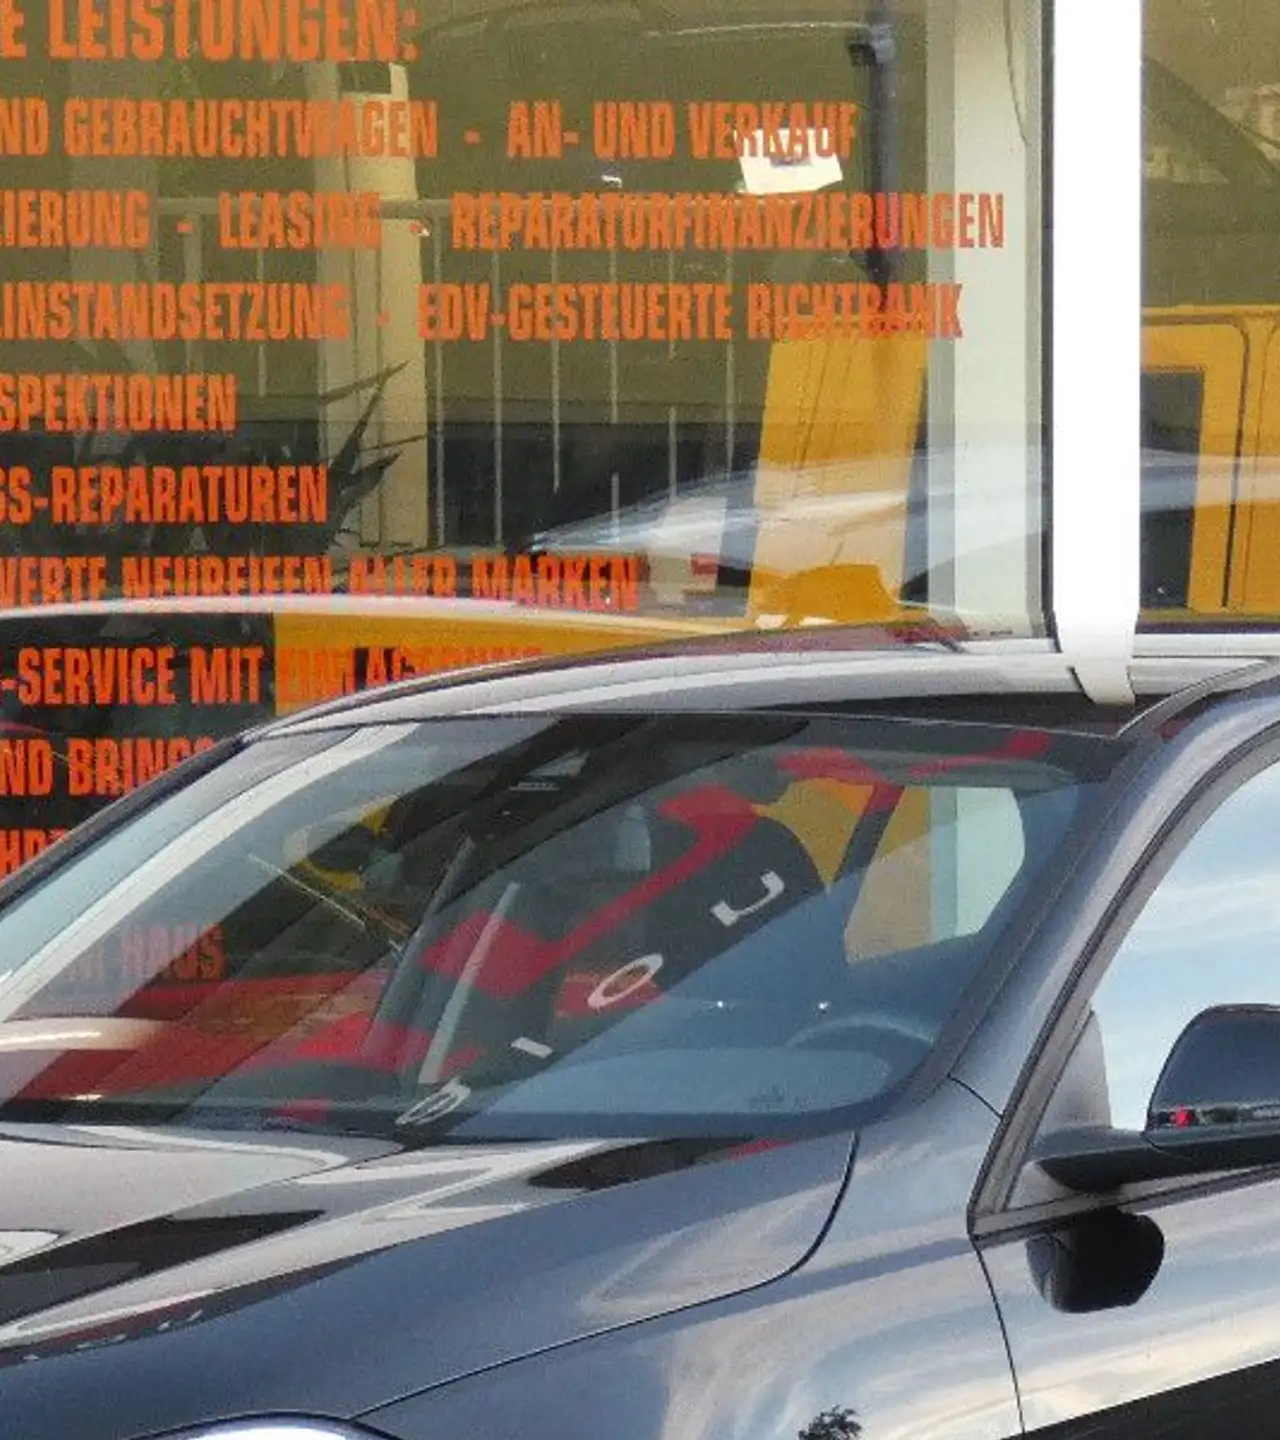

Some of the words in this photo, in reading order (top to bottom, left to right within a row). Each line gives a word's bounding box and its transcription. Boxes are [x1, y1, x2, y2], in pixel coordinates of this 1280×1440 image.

[47, 0, 419, 60] LEISTUNGEN:
[64, 99, 438, 158] GEBRAUCHTWAGEN
[507, 100, 579, 160] AN-
[593, 102, 675, 159] UND
[688, 102, 859, 160] VERKAUF
[219, 190, 382, 249] LEASING
[451, 192, 1005, 250] REPARATURFINANZIERUNGEN
[419, 283, 733, 341] EDV-GESTEUERTE
[746, 283, 964, 341] RICHTBANK
[472, 555, 639, 612] MARKEN
[189, 647, 265, 706] MIT
[66, 736, 215, 798] BRIN
